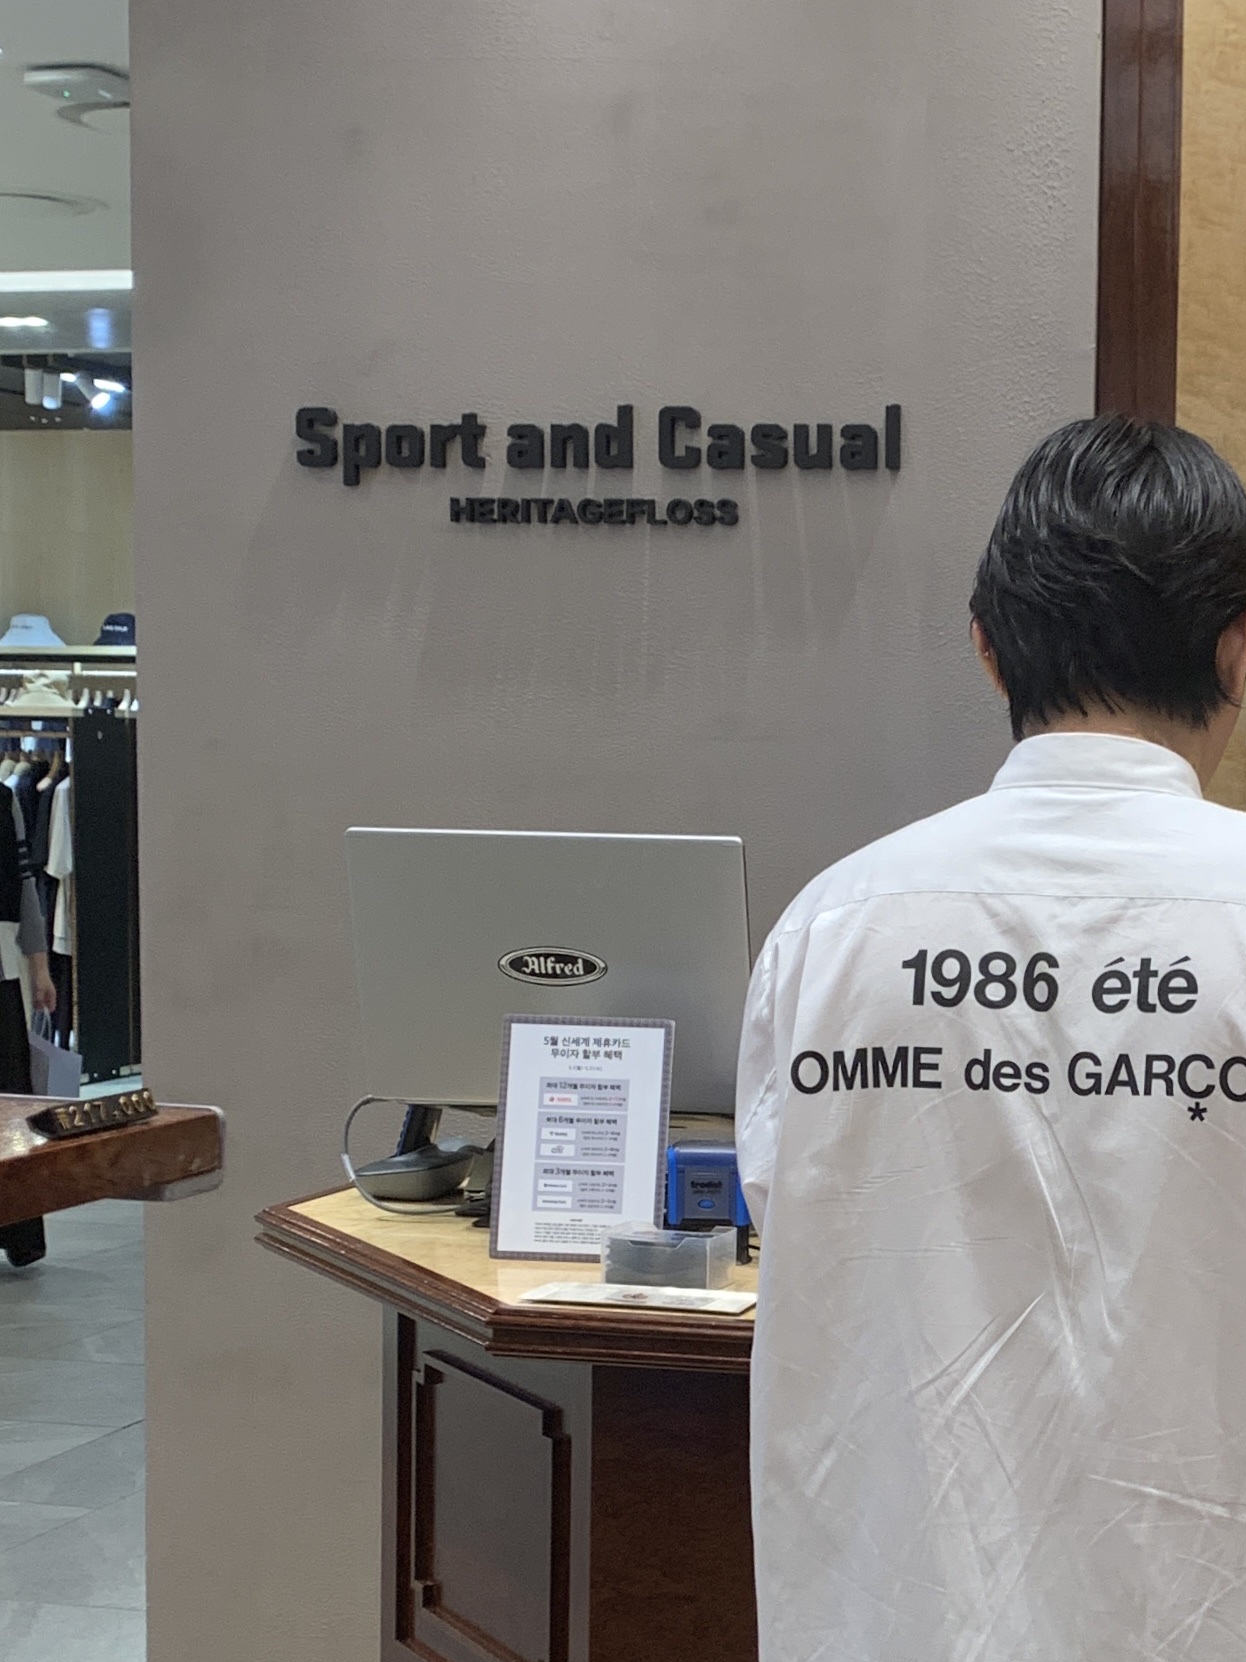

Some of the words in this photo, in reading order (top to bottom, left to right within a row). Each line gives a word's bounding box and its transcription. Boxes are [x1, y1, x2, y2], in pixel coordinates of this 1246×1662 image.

[295, 407, 487, 486] Sport
[506, 404, 634, 470] and
[658, 403, 901, 470] Casual
[449, 497, 740, 526] HERITAGEFLOSS
[522, 956, 584, 975] Alfred
[901, 949, 1060, 1012] 1986
[1091, 956, 1199, 1014] été
[964, 1049, 1050, 1094] des
